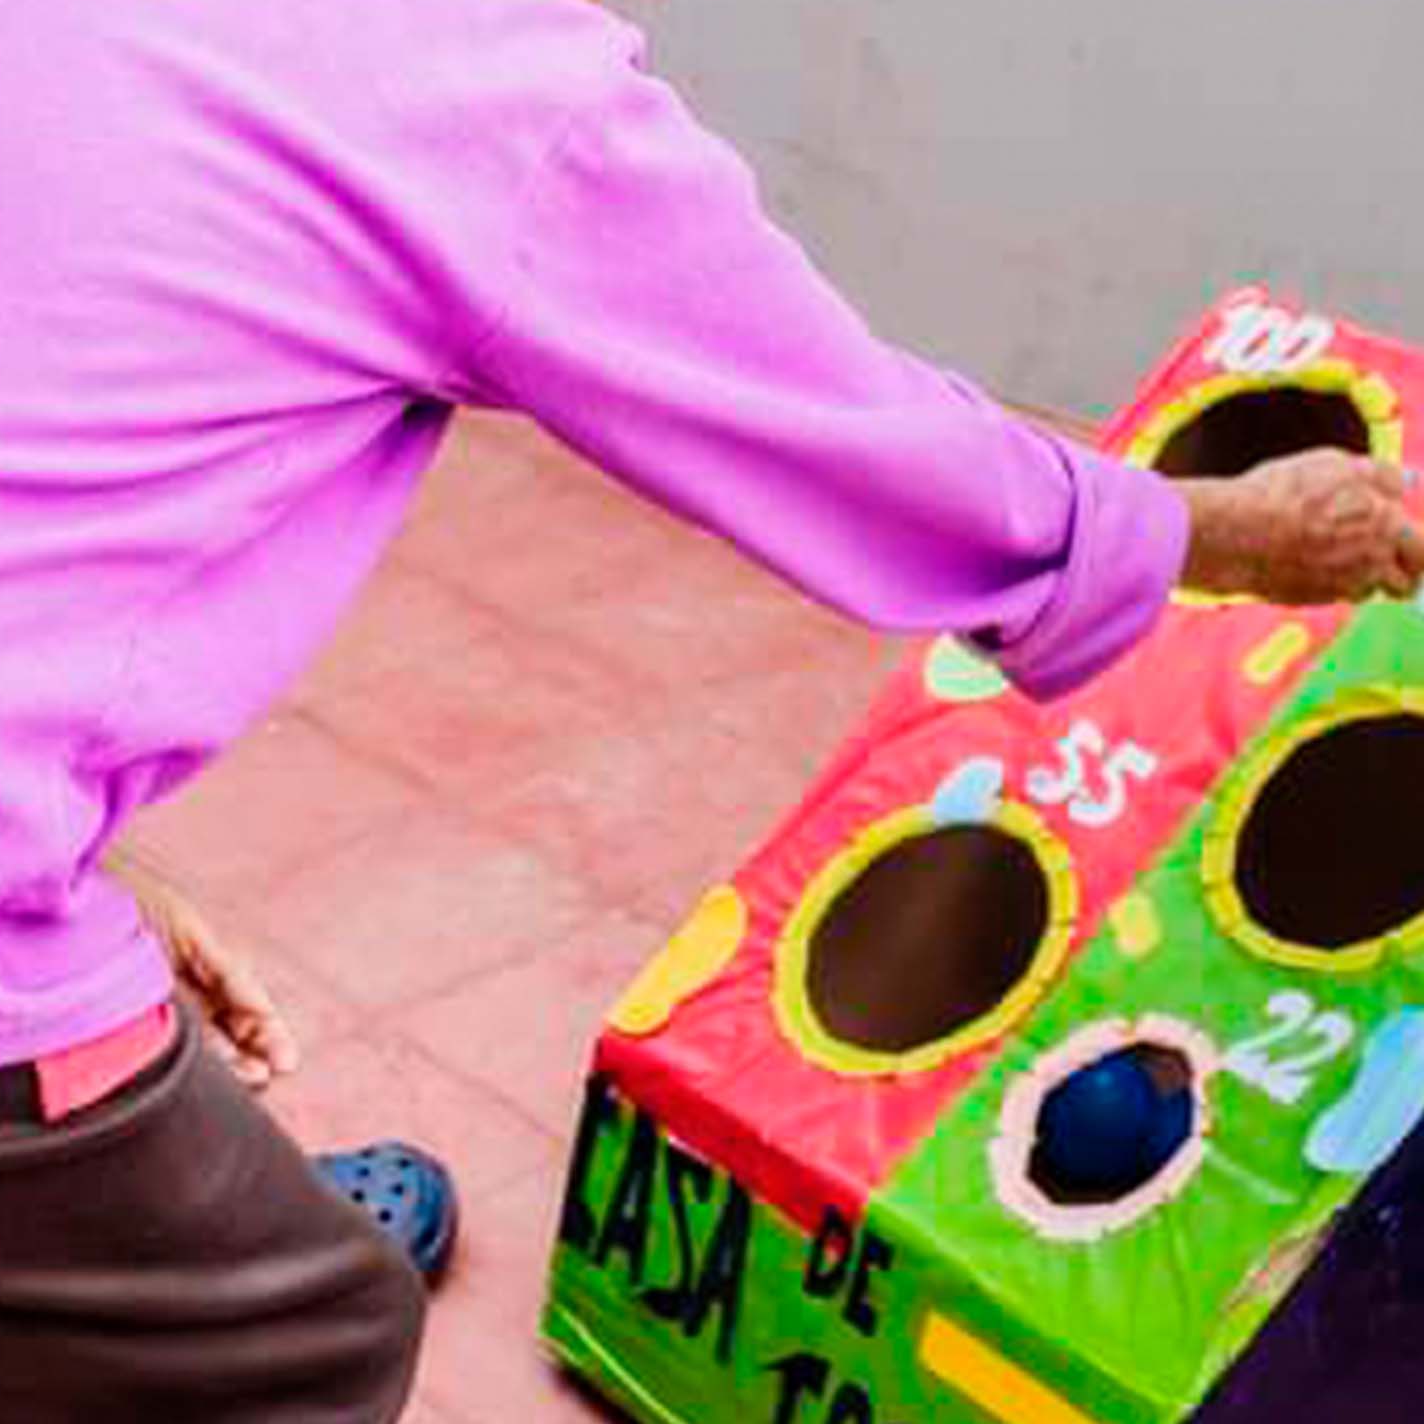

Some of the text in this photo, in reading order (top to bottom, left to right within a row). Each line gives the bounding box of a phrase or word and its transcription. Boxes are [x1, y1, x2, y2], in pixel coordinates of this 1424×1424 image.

[1025, 719, 1157, 825] 55
[1226, 987, 1355, 1103] 22
[560, 1073, 752, 1364] CASA
